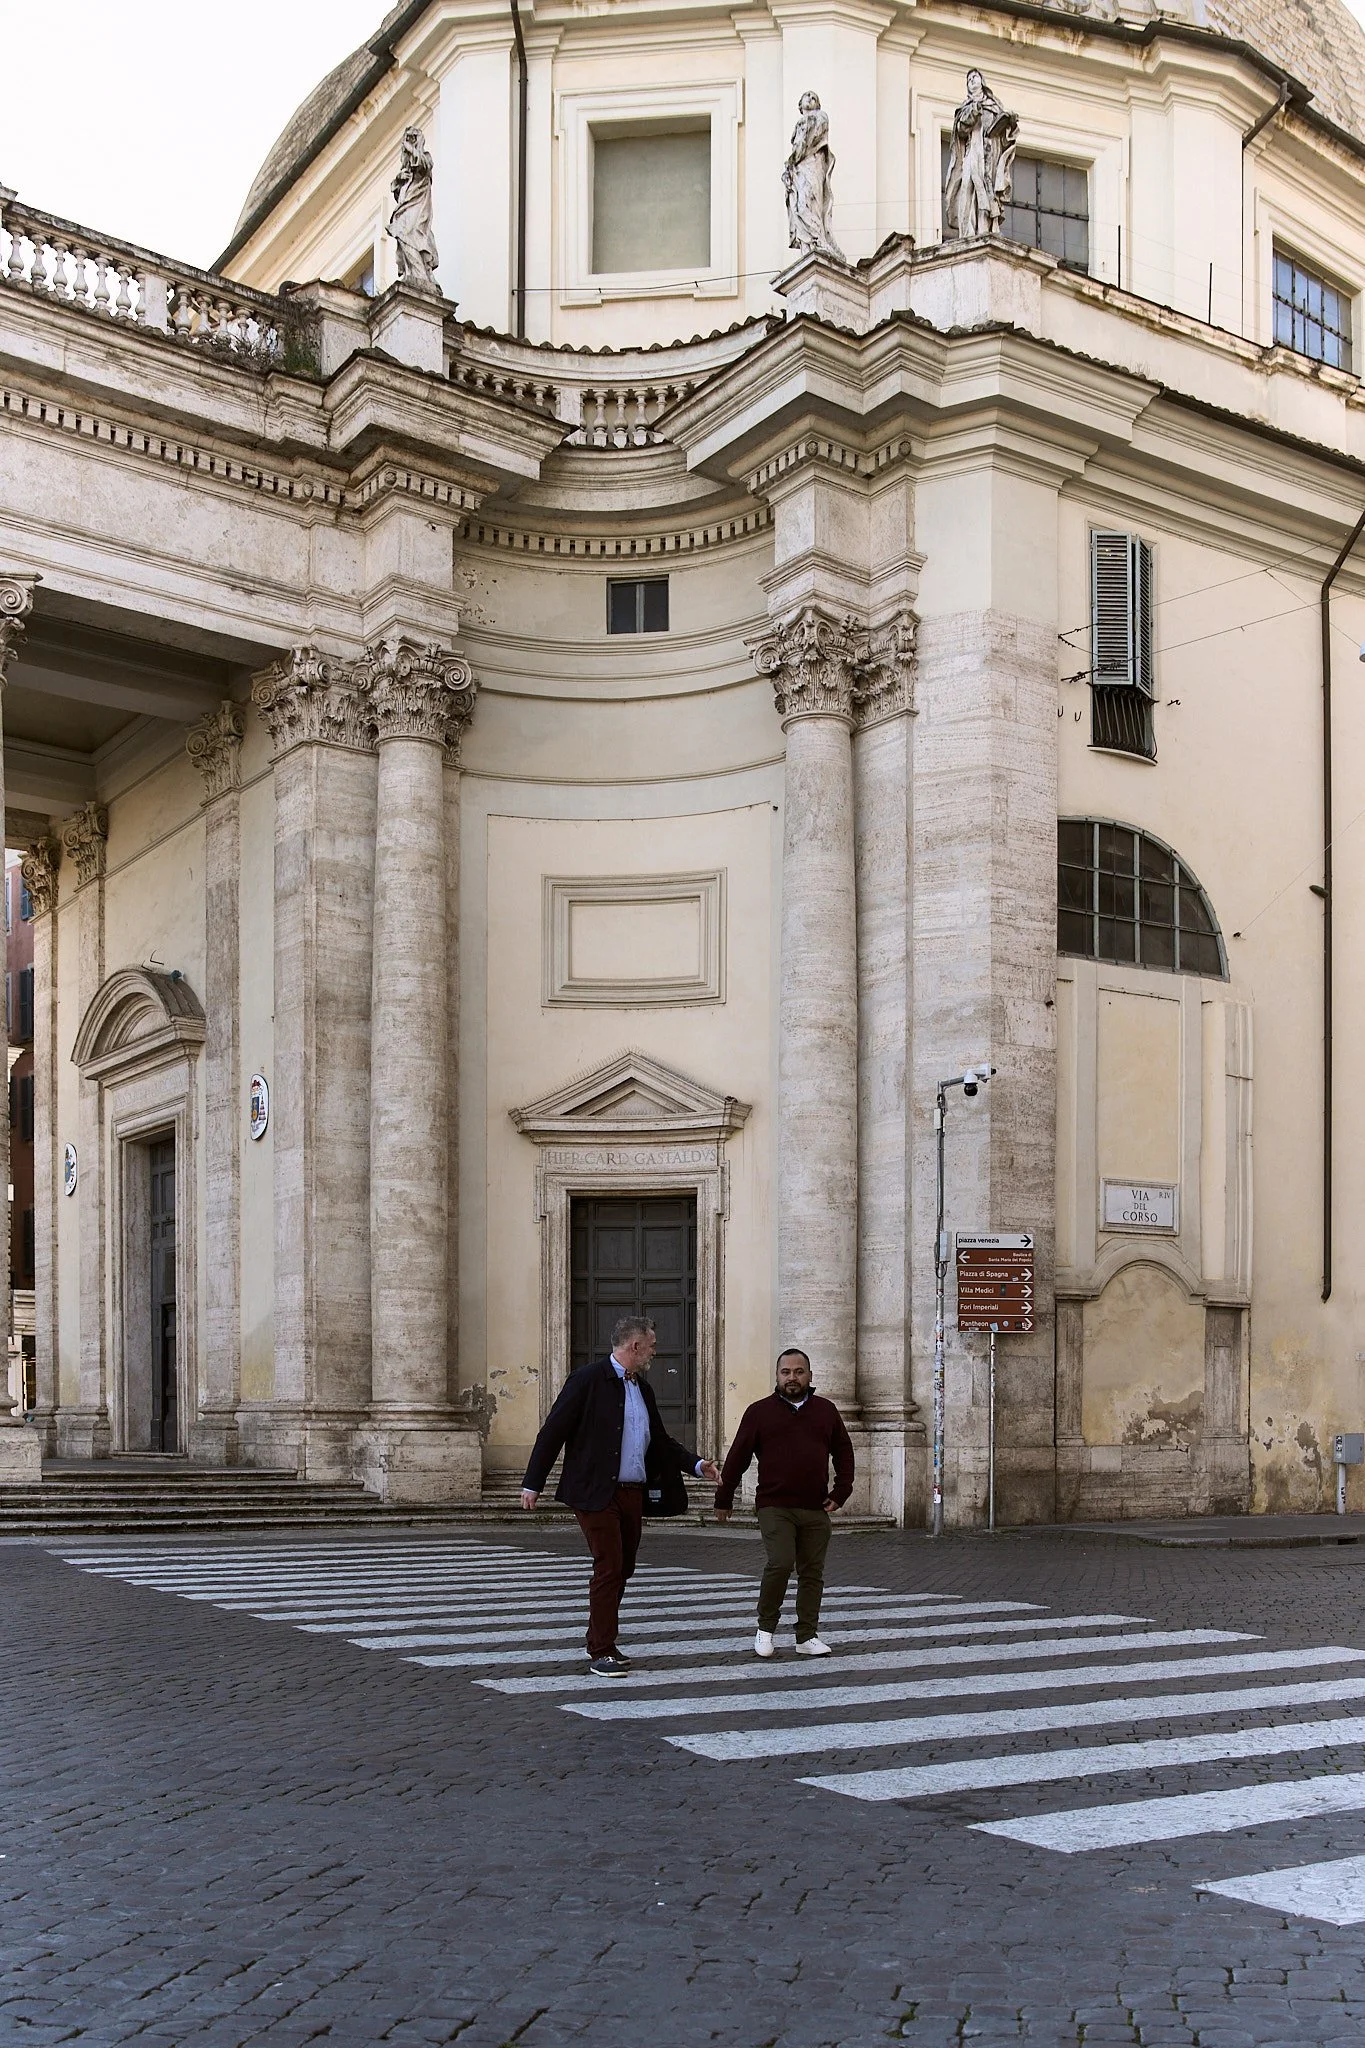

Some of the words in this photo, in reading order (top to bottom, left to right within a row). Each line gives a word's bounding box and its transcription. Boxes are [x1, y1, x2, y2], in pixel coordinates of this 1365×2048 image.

[635, 1149, 716, 1165] GASTALDVS
[1132, 1190, 1149, 1200] VIA
[1123, 1211, 1158, 1222] CORSO
